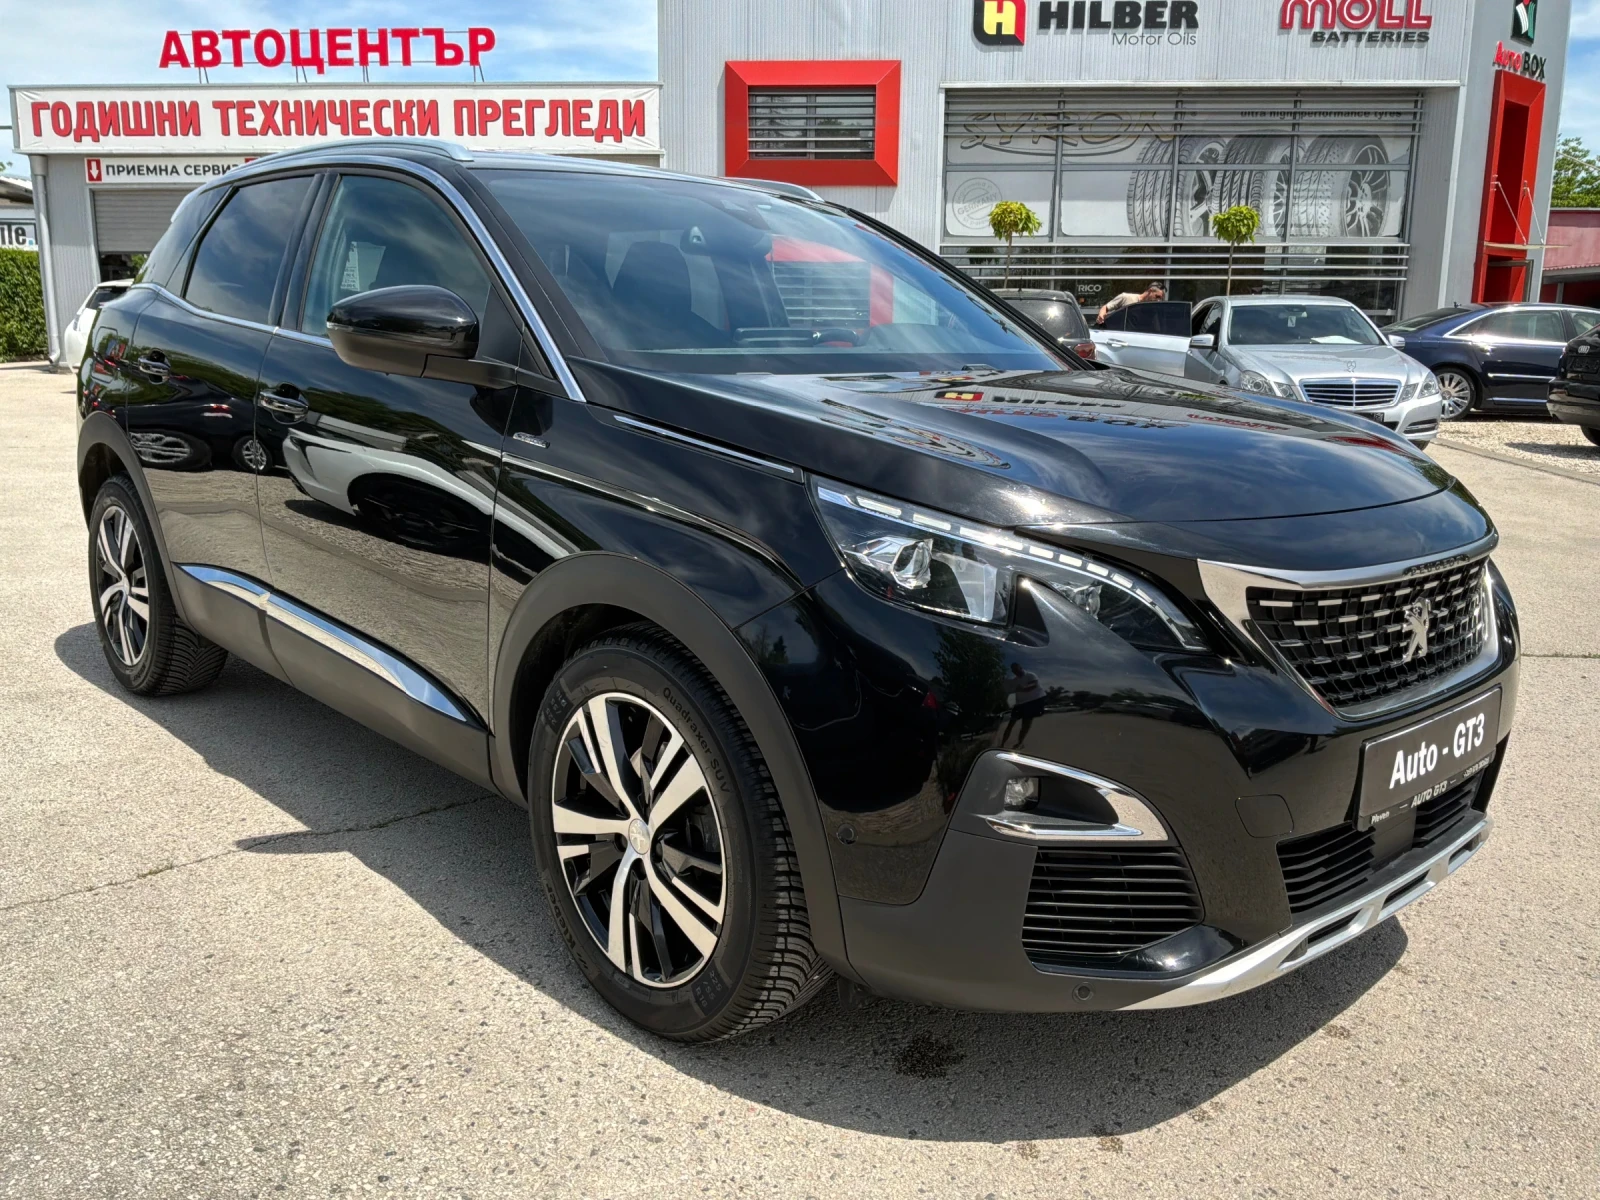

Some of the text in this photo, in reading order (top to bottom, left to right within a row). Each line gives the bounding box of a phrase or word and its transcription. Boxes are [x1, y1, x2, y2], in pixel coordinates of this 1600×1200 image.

[1039, 1, 1199, 29] HILBER
[159, 27, 496, 74] АВТОЦЕНТЪР
[1112, 32, 1197, 46] Motor Oils
[1312, 31, 1430, 43] BATTERIES
[1522, 51, 1547, 79] BOX
[31, 99, 646, 143] ГОДИШНИ ТЕХНИЧЕСКИ ПРЕГЛЕДИ
[105, 164, 181, 176] ПРИЕМНА
[662, 686, 731, 794] Quadraxer SUV
[1389, 741, 1438, 790] Auto
[1453, 712, 1485, 758] GT3
[1371, 780, 1448, 825] Pleven AUTO GT3
